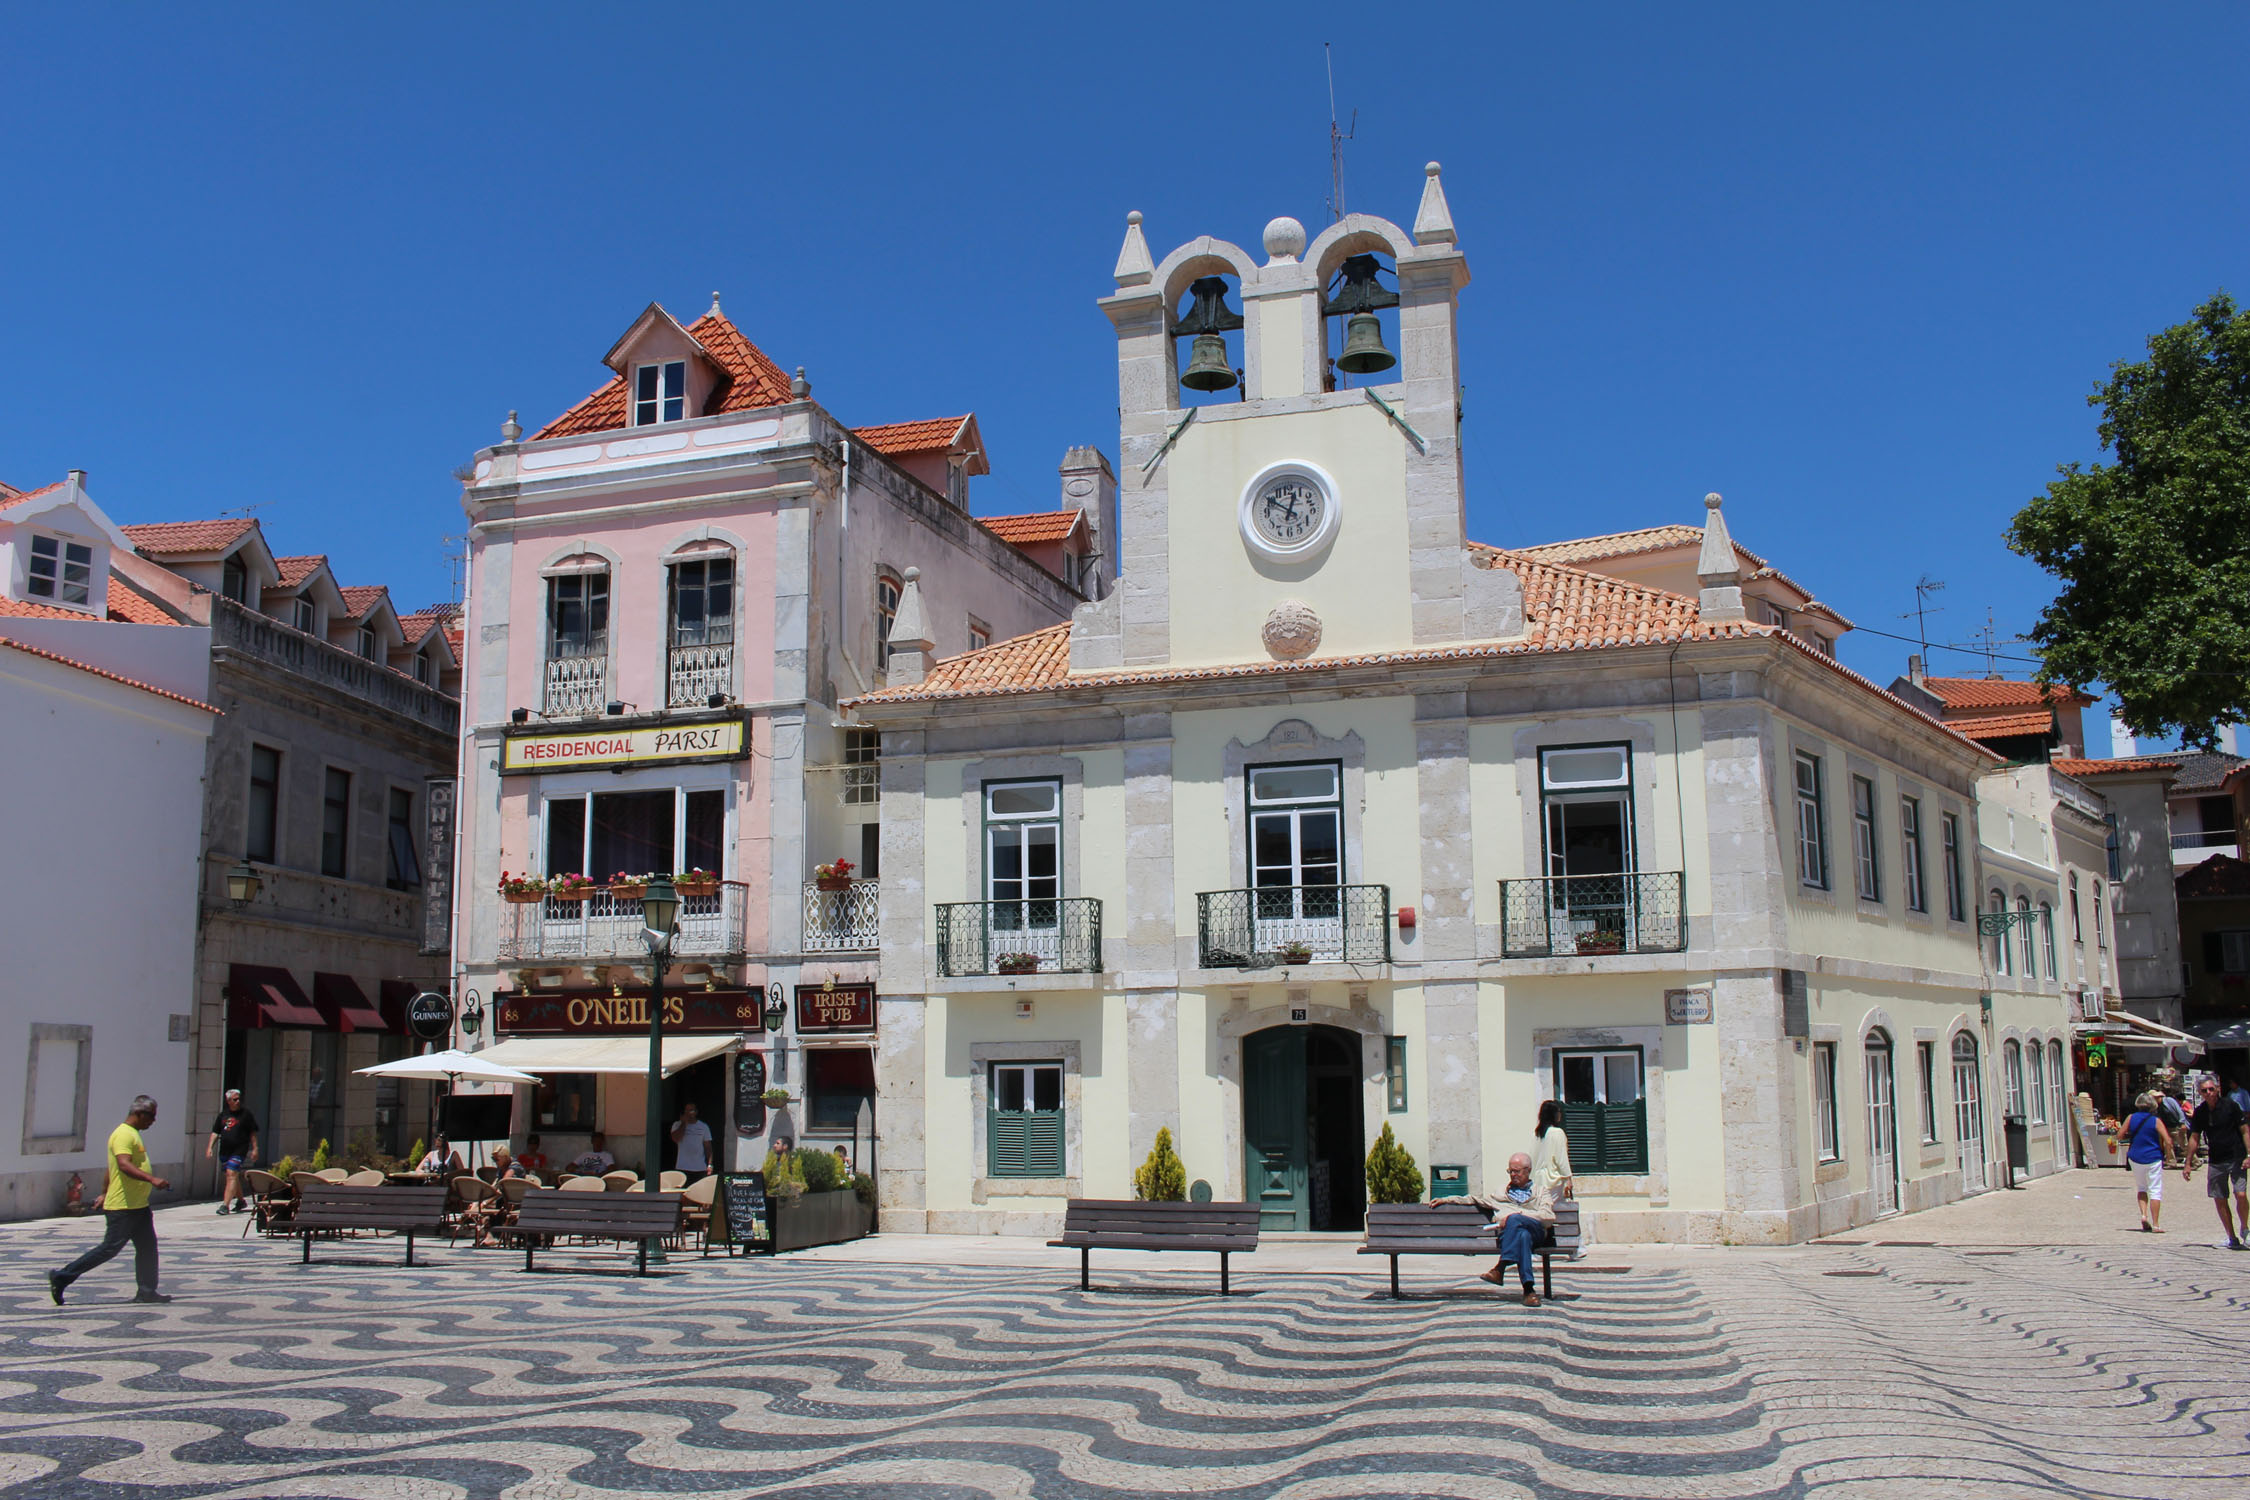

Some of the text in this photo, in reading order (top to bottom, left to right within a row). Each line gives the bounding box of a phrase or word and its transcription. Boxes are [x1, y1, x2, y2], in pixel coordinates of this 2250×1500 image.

[1283, 484, 1293, 496] 12
[1298, 487, 1302, 497] 1
[1305, 492, 1312, 503] 2
[1263, 507, 1270, 518] 9
[1309, 503, 1316, 515] 3
[1276, 525, 1282, 537] 7
[1286, 526, 1293, 537] 6
[1296, 522, 1303, 534] 5
[524, 729, 720, 759] RESIDENCIAL PARSI
[814, 992, 857, 1008] IRISH
[412, 1011, 449, 1021] GUINNESS
[505, 996, 752, 1026] 88 O'NEIL'S 88
[820, 1007, 852, 1023] PUB
[1295, 1010, 1304, 1020] 75
